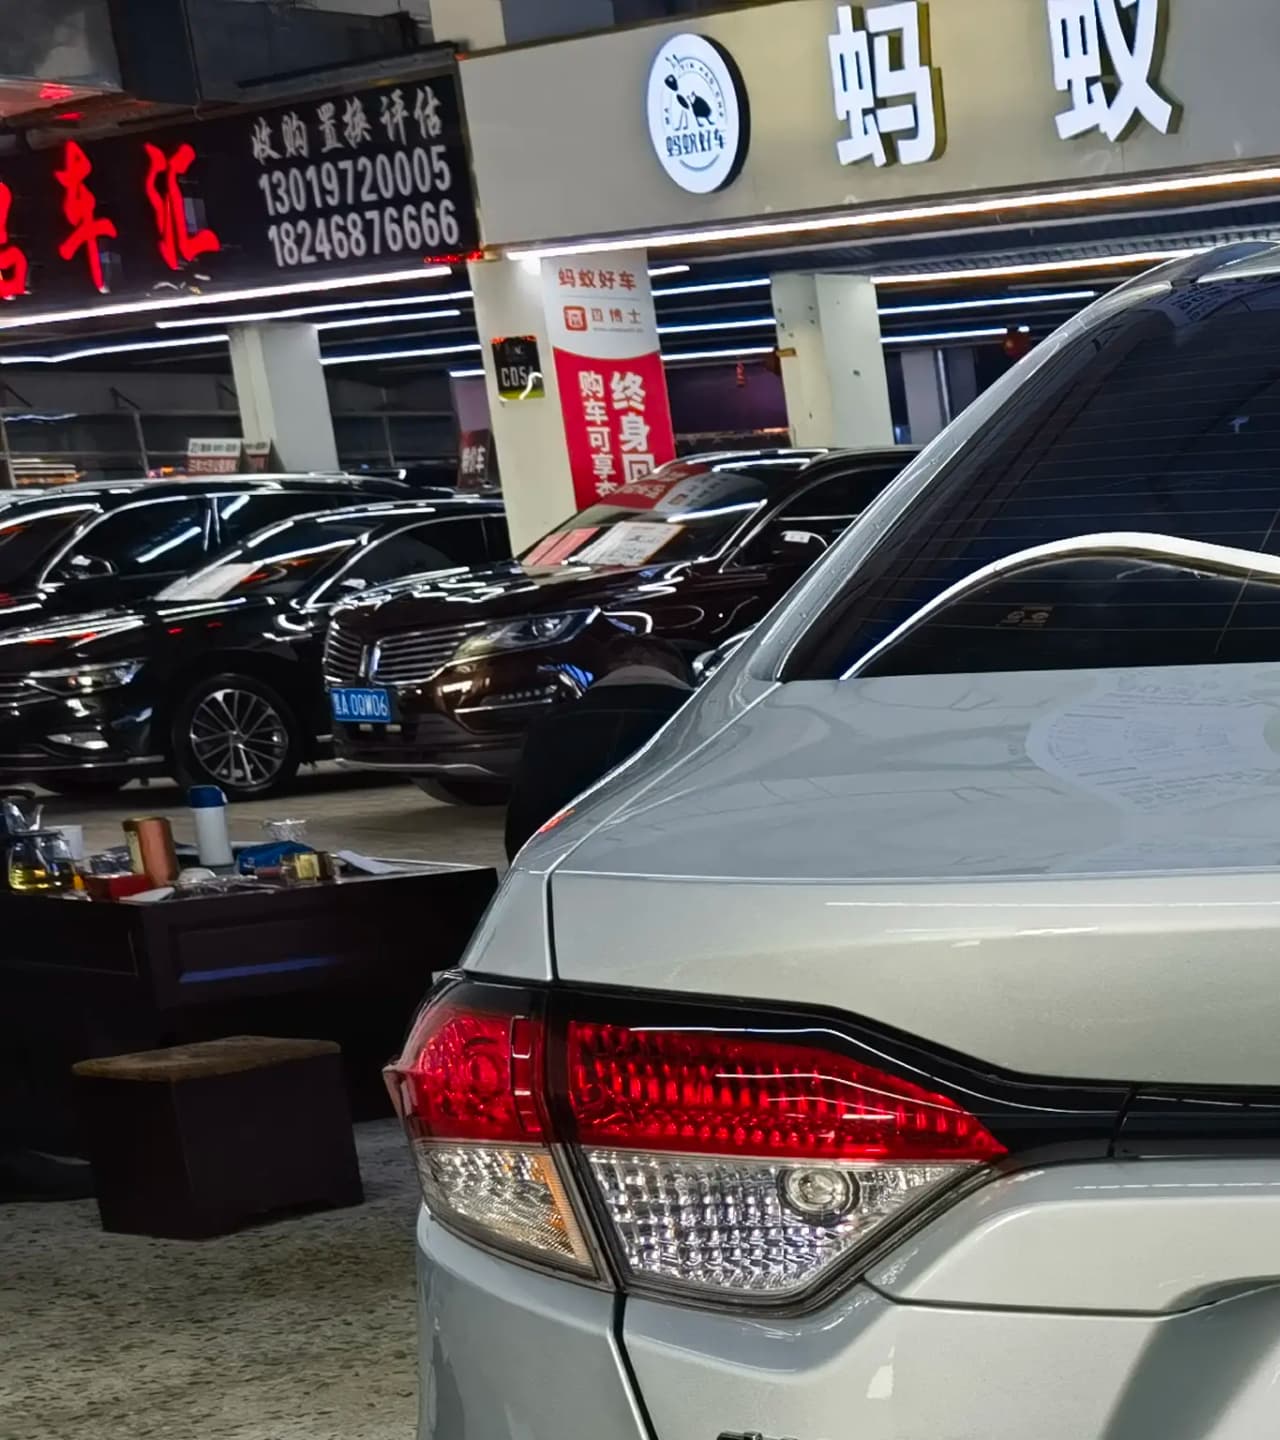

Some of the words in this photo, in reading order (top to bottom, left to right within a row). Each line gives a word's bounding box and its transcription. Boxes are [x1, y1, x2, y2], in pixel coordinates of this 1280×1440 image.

[666, 128, 725, 158] 蚂蚁好车
[259, 145, 451, 216] 13019720005
[268, 199, 459, 267] 18246876666
[558, 268, 637, 291] 蚂蚁好车
